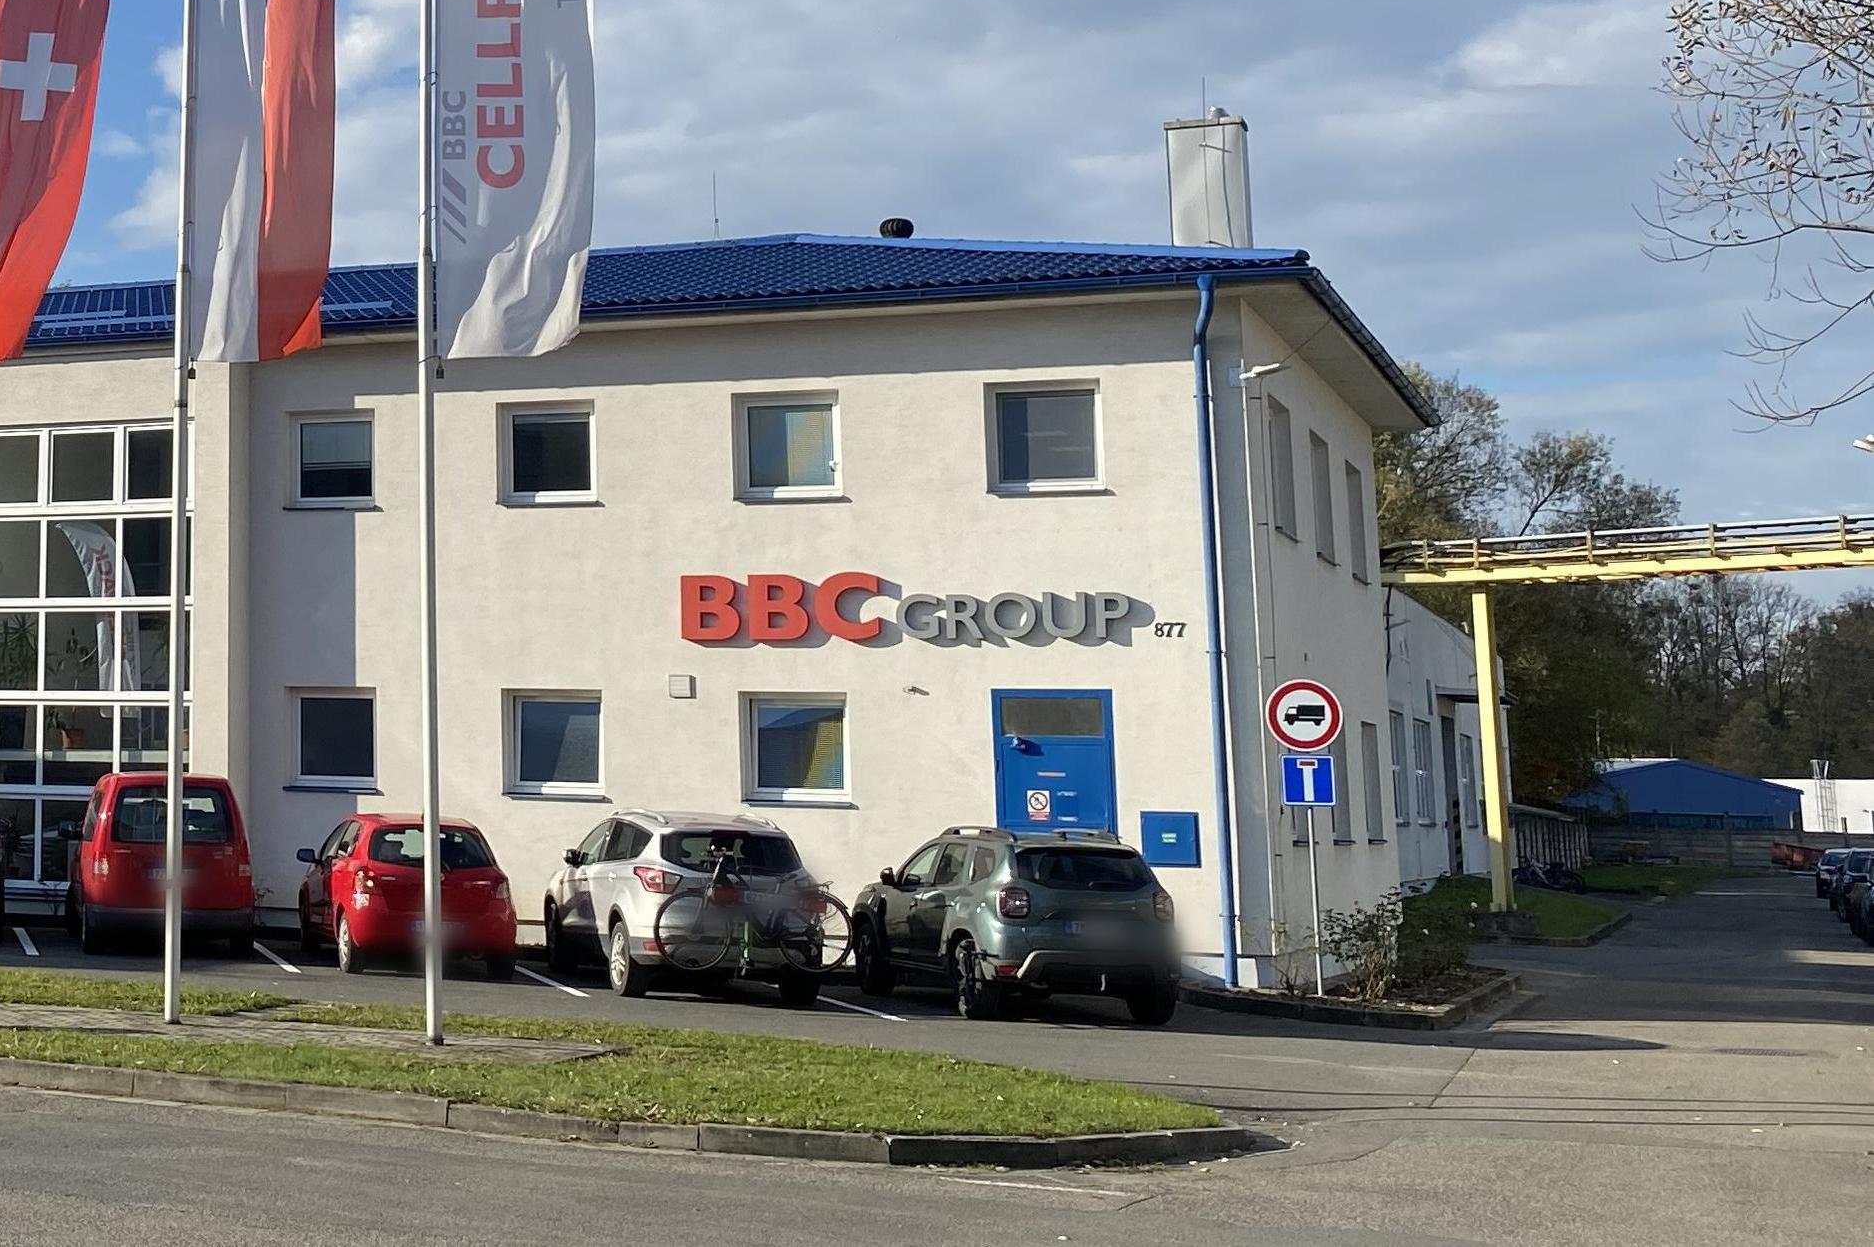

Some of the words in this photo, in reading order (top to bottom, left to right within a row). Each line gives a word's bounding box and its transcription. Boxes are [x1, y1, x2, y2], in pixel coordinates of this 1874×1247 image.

[441, 90, 467, 160] BBC
[680, 571, 882, 641] BBC
[895, 591, 1131, 640] GROUP
[1154, 621, 1188, 638] 877
